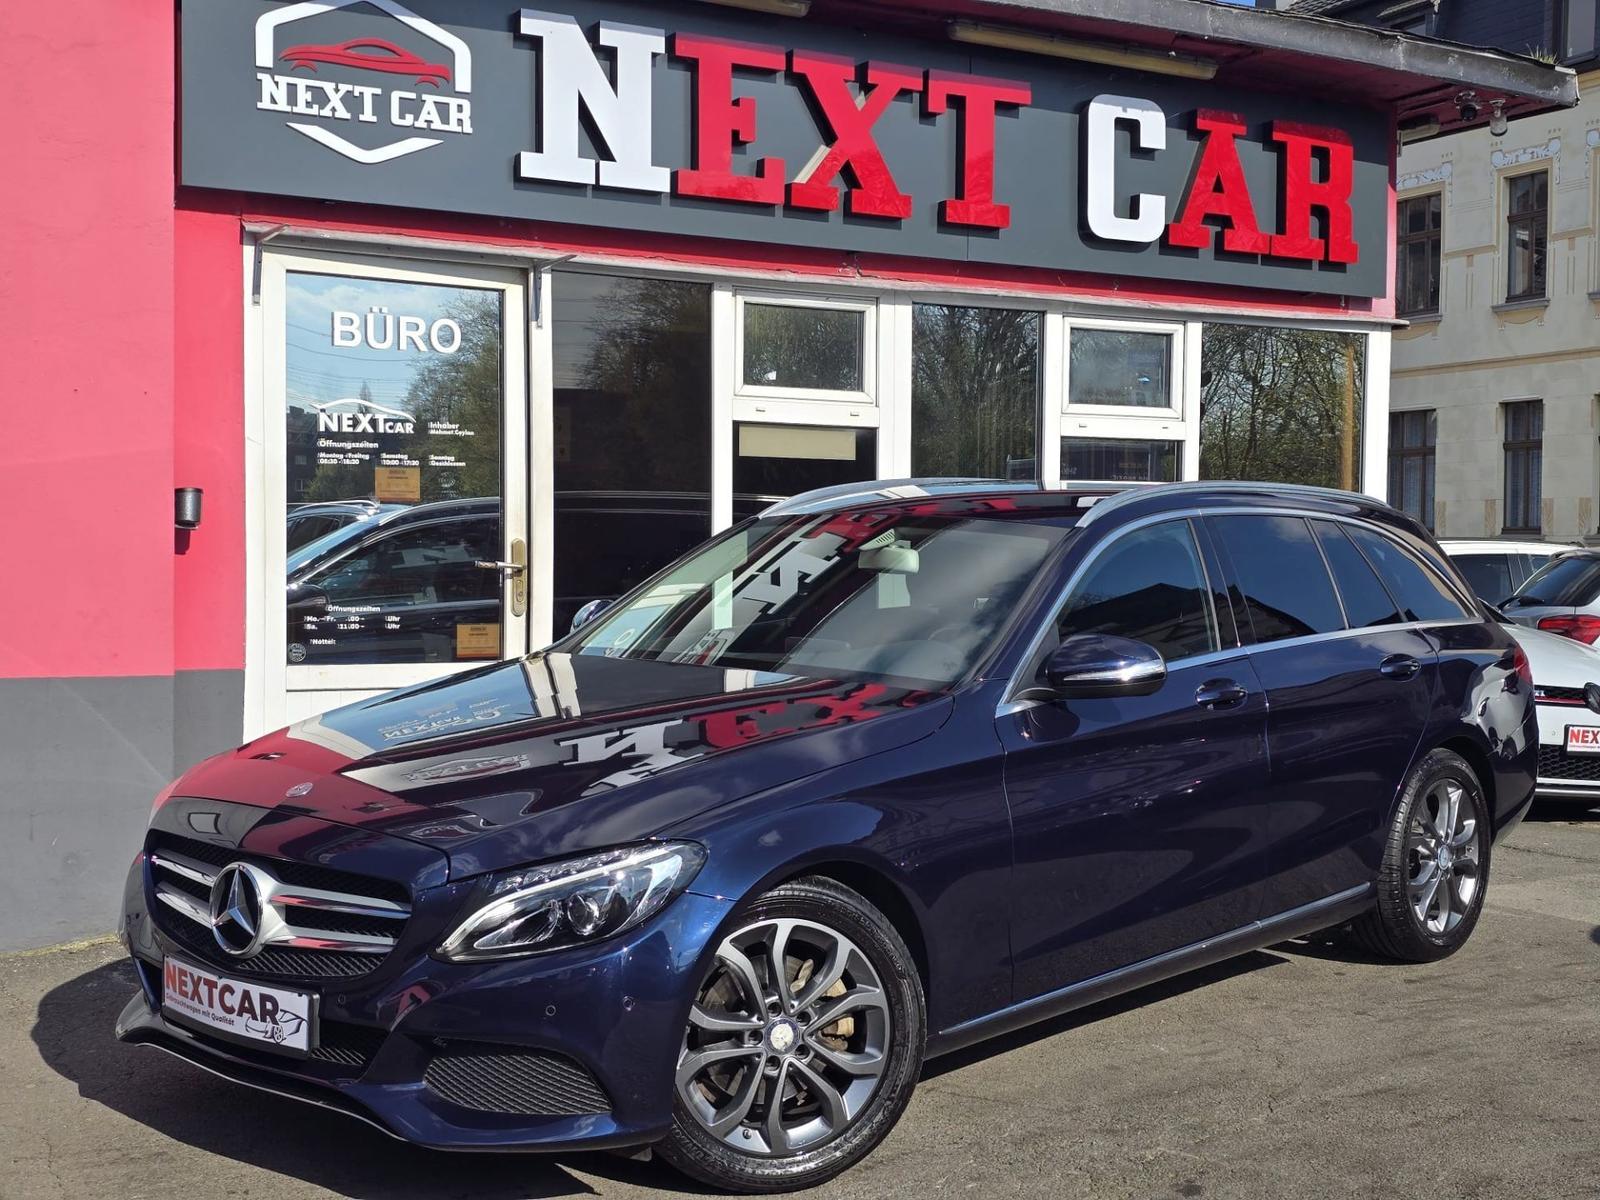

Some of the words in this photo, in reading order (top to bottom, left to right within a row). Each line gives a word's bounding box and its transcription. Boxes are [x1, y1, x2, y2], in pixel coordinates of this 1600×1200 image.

[256, 73, 381, 123] NEXT
[389, 90, 473, 135] CAR
[520, 8, 1031, 229] NEXT
[1087, 94, 1359, 264] CAR
[331, 307, 462, 355] BÜRO
[318, 437, 379, 450] Öffnungszeiten
[429, 421, 459, 430] Inhaber
[326, 604, 381, 613] Öffnungszeiten
[165, 961, 280, 1026] NEXTCAR
